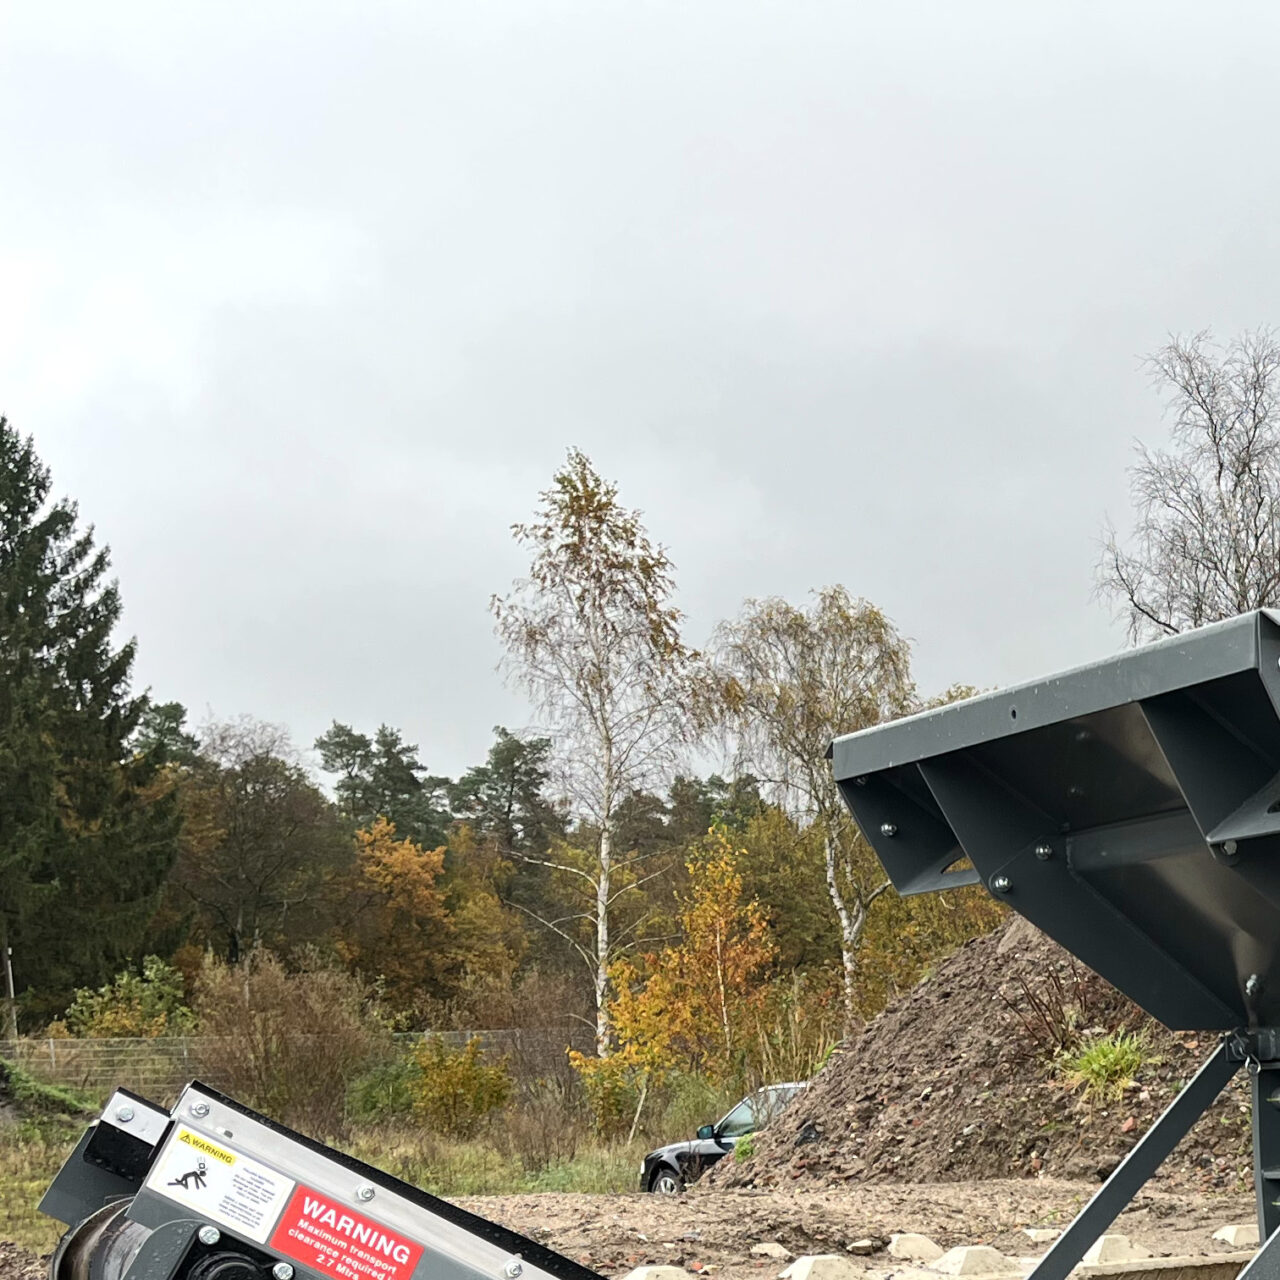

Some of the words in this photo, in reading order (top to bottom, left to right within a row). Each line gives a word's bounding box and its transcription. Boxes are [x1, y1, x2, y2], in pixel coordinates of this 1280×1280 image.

[191, 1137, 233, 1164] WARNING
[288, 1228, 339, 1258] clearance
[341, 1252, 385, 1280] required
[297, 1219, 348, 1249] Maximum
[349, 1245, 397, 1275] transport
[302, 1196, 411, 1265] WARNING
[315, 1253, 335, 1268] 2.7
[335, 1263, 360, 1280] Mtrs
